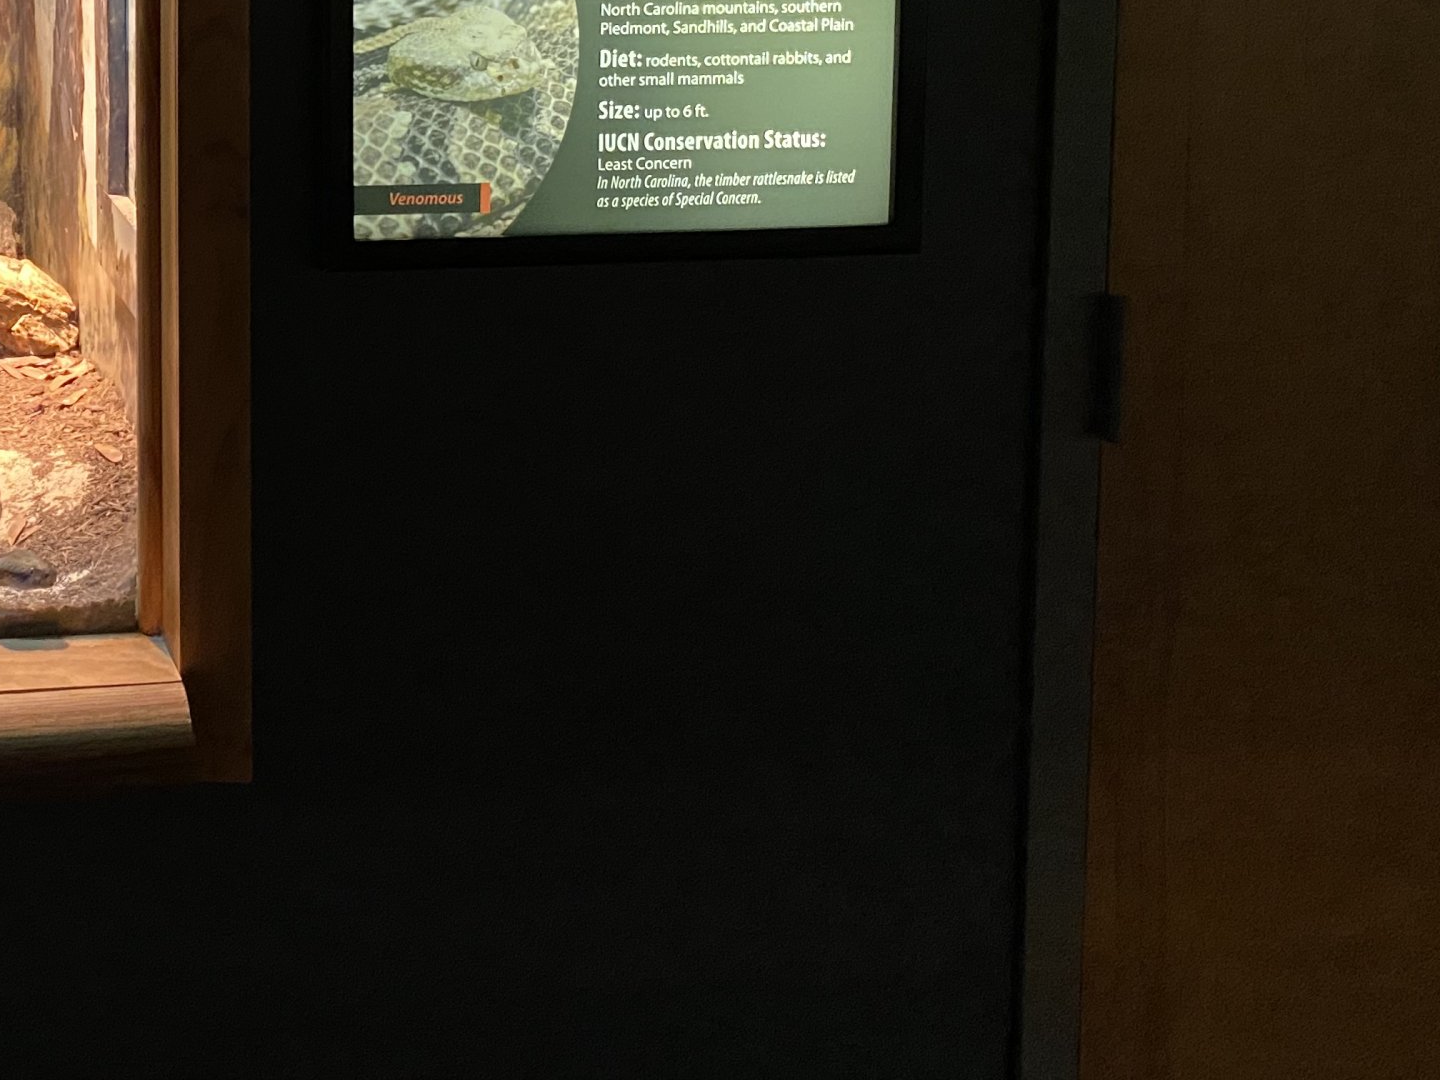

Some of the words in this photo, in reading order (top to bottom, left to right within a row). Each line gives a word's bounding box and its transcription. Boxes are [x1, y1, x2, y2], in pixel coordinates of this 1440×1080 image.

[600, 2, 640, 16] North
[643, 1, 699, 15] Carolina
[701, 1, 778, 16] mountains,
[780, 0, 842, 13] southern
[600, 21, 670, 36] Piedmont,
[672, 19, 737, 35] Sandhills,
[739, 19, 766, 32] and
[768, 18, 818, 32] Coastal
[820, 18, 854, 31] Plain
[599, 49, 642, 68] Diet:
[645, 53, 701, 69] rodents,
[703, 51, 769, 66] cottontail
[772, 51, 822, 66] rabbits,
[824, 50, 851, 64] and
[598, 73, 636, 87] other
[638, 72, 674, 86] small
[677, 71, 744, 85] mammals
[598, 101, 639, 119] Size:
[644, 108, 662, 121] up
[664, 107, 680, 118] to
[682, 105, 692, 117] 6
[694, 104, 709, 117] ft.
[598, 133, 639, 152] IUCN
[643, 130, 760, 150] Conservation
[763, 130, 826, 148] Status:
[597, 158, 632, 170] Least
[635, 157, 692, 170] Concern
[596, 176, 608, 189] In
[610, 175, 641, 189] North
[644, 174, 691, 190] Carolina,
[694, 173, 712, 187] the
[714, 172, 751, 186] timber
[752, 171, 813, 185] rattlesnake
[814, 171, 824, 184] is
[825, 169, 856, 183] listed
[388, 192, 464, 205] Venomous
[596, 197, 609, 207] as
[611, 197, 619, 207] a
[620, 194, 659, 210] species
[661, 192, 675, 206] of
[674, 191, 715, 208] Special
[715, 191, 761, 204] Concern.
